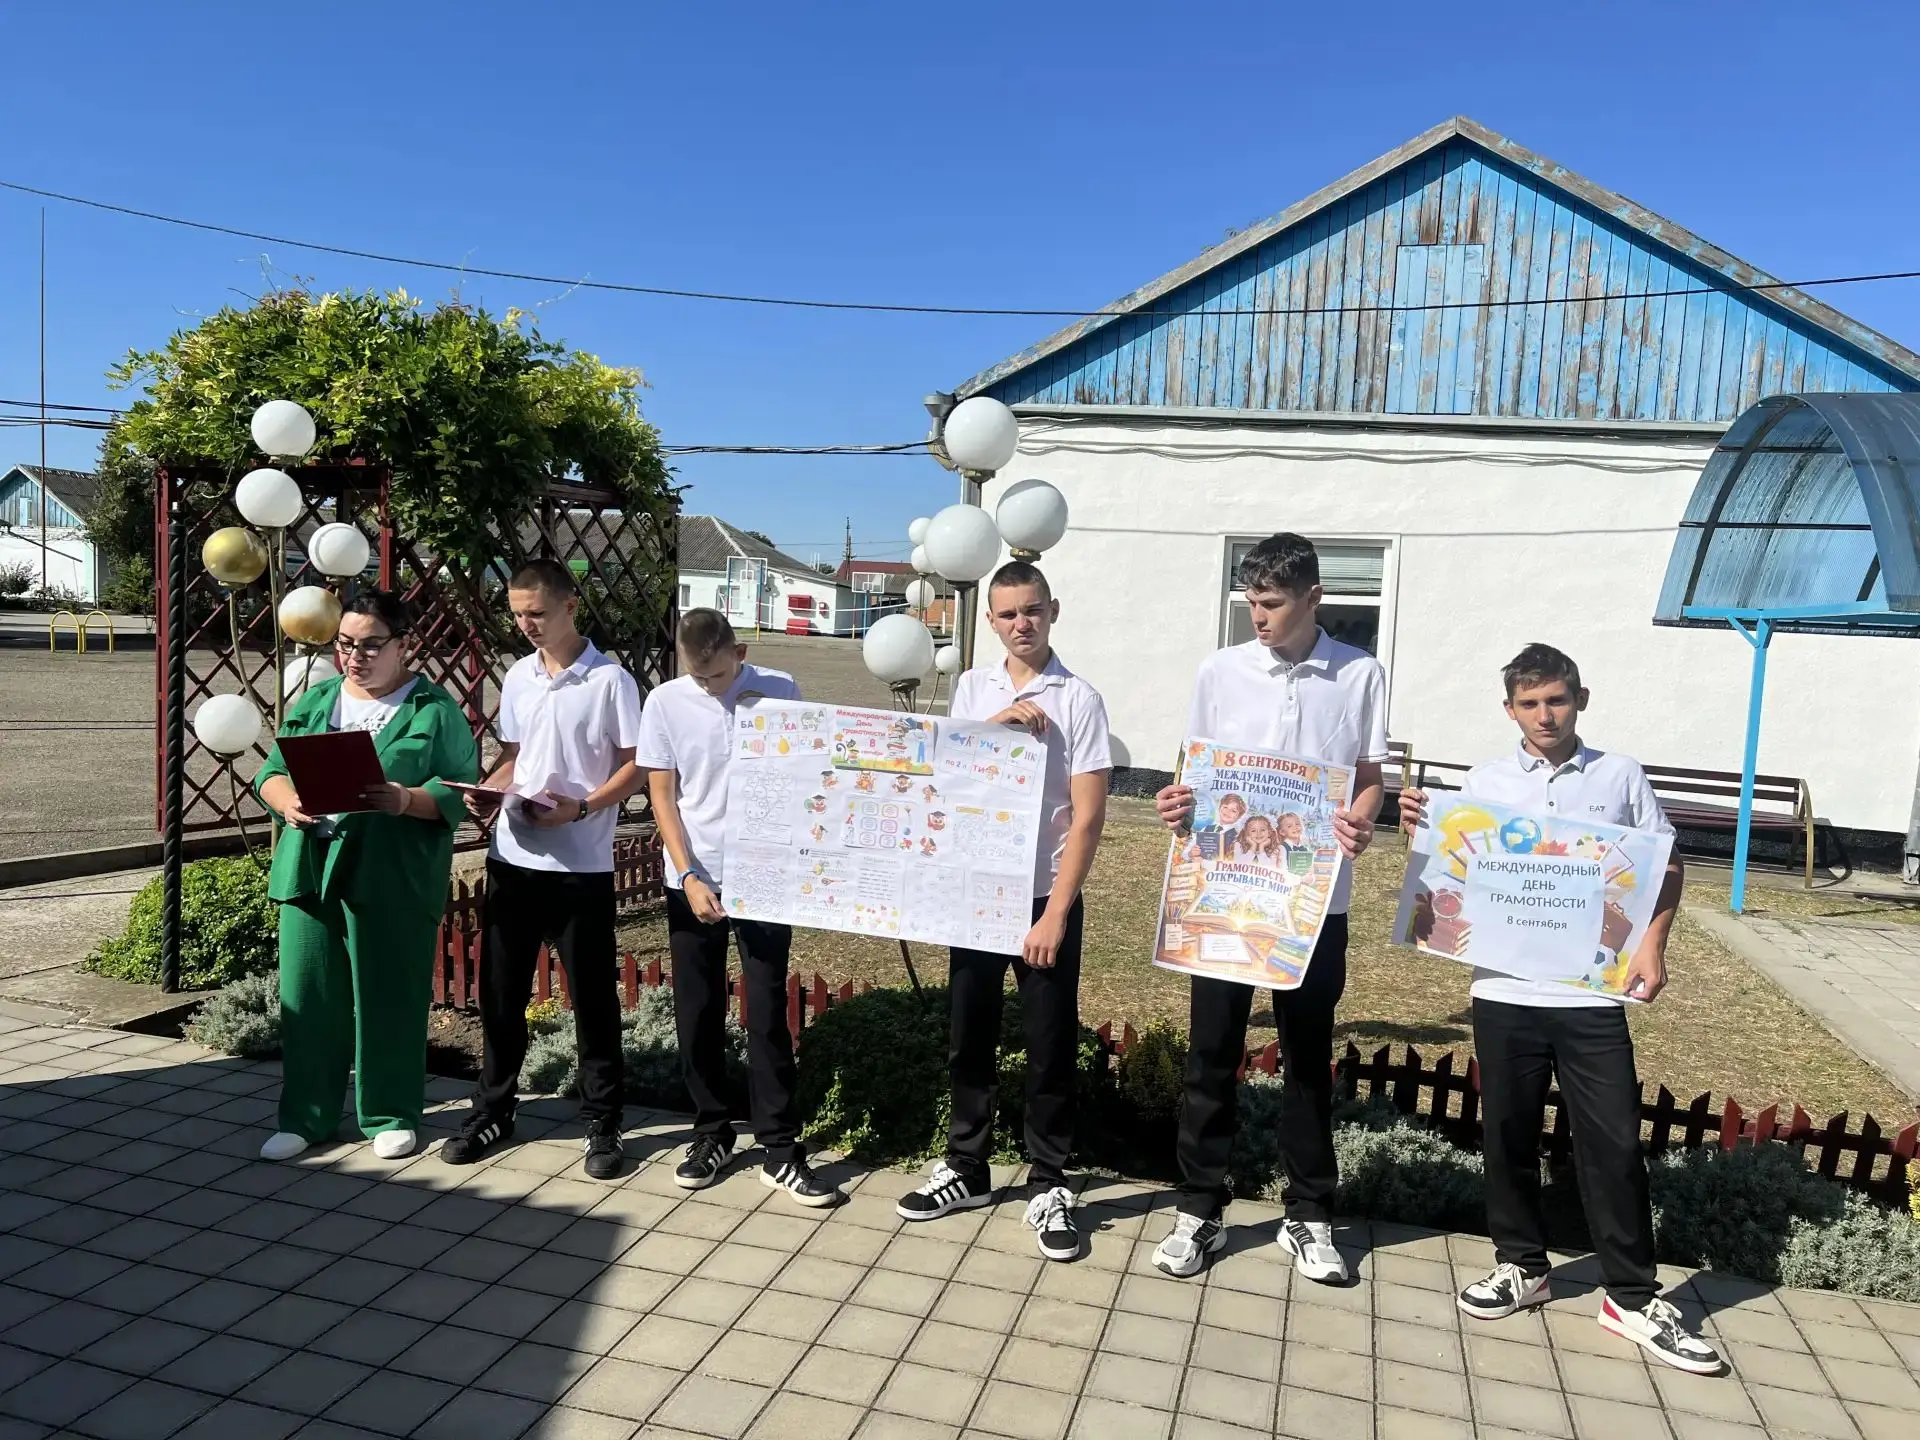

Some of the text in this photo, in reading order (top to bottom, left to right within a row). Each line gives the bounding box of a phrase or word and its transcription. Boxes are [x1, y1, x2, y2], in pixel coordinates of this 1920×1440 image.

[836, 709, 892, 720] Международный
[842, 728, 886, 737] грамотности
[1224, 752, 1308, 777] 8 СЕНТЯБРЯ
[1214, 768, 1313, 794] МЕЖДУНАРОДНЫЙ
[1210, 780, 1240, 792] ДЕНЬ
[1241, 782, 1316, 807] ГРАМОТНОСТИ
[1215, 860, 1286, 883] ГРАМОТНОСТЬ
[1477, 860, 1601, 877] МЕЖДУНАРОДНЫЙ
[1205, 871, 1267, 888] ОТКРЫВАЕТ
[1268, 881, 1293, 897] МИР!
[1522, 880, 1556, 892] ДЕНЬ
[1490, 893, 1586, 909] ГРАМОТНОСТИ
[1507, 915, 1568, 930] 8 сентября
